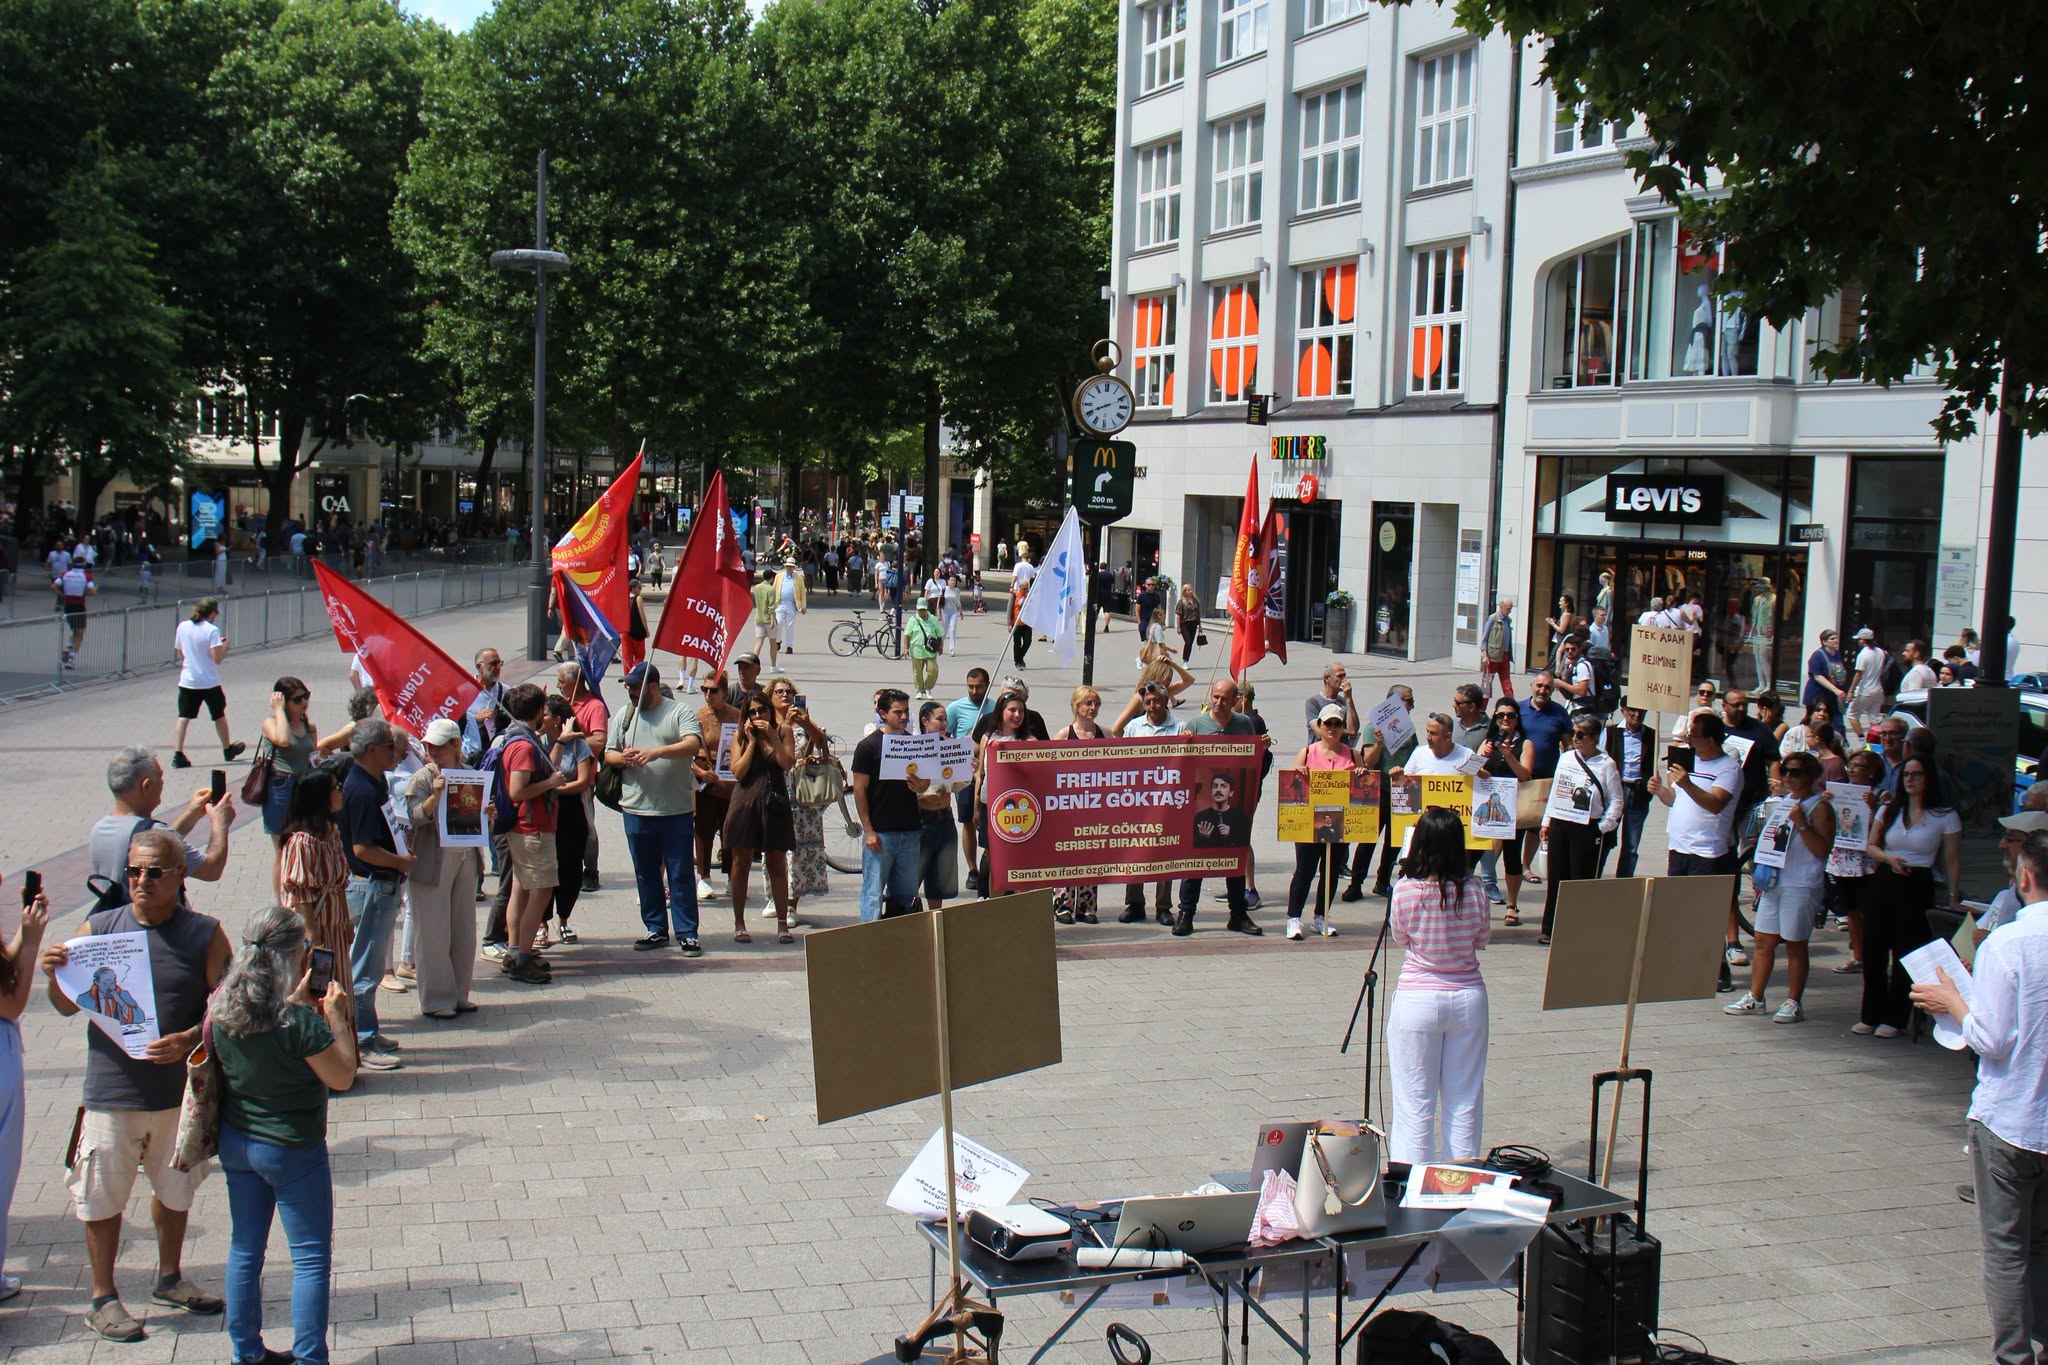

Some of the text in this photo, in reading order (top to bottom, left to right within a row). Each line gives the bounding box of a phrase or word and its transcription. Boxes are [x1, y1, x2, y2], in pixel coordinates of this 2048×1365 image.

[1271, 436, 1325, 459] BUTLERS
[321, 495, 351, 512] C&A
[1637, 629, 1685, 645] TEK ADAM
[1000, 744, 1253, 761] Finger weg von der Kunst- und Meinungsfreiheit!
[1056, 766, 1181, 788] FREIHEIT FÜR
[1045, 789, 1190, 811] DENİZ GÖKTAŞ!
[1004, 814, 1028, 825] DIDF
[1074, 822, 1163, 837] DENİZ GÖKTAŞ
[1055, 835, 1180, 852] SERBEST BIRAKILSIN!
[1010, 858, 1236, 880] Sanat ve ifade özgürlüğünden ellerinizi çekin!
